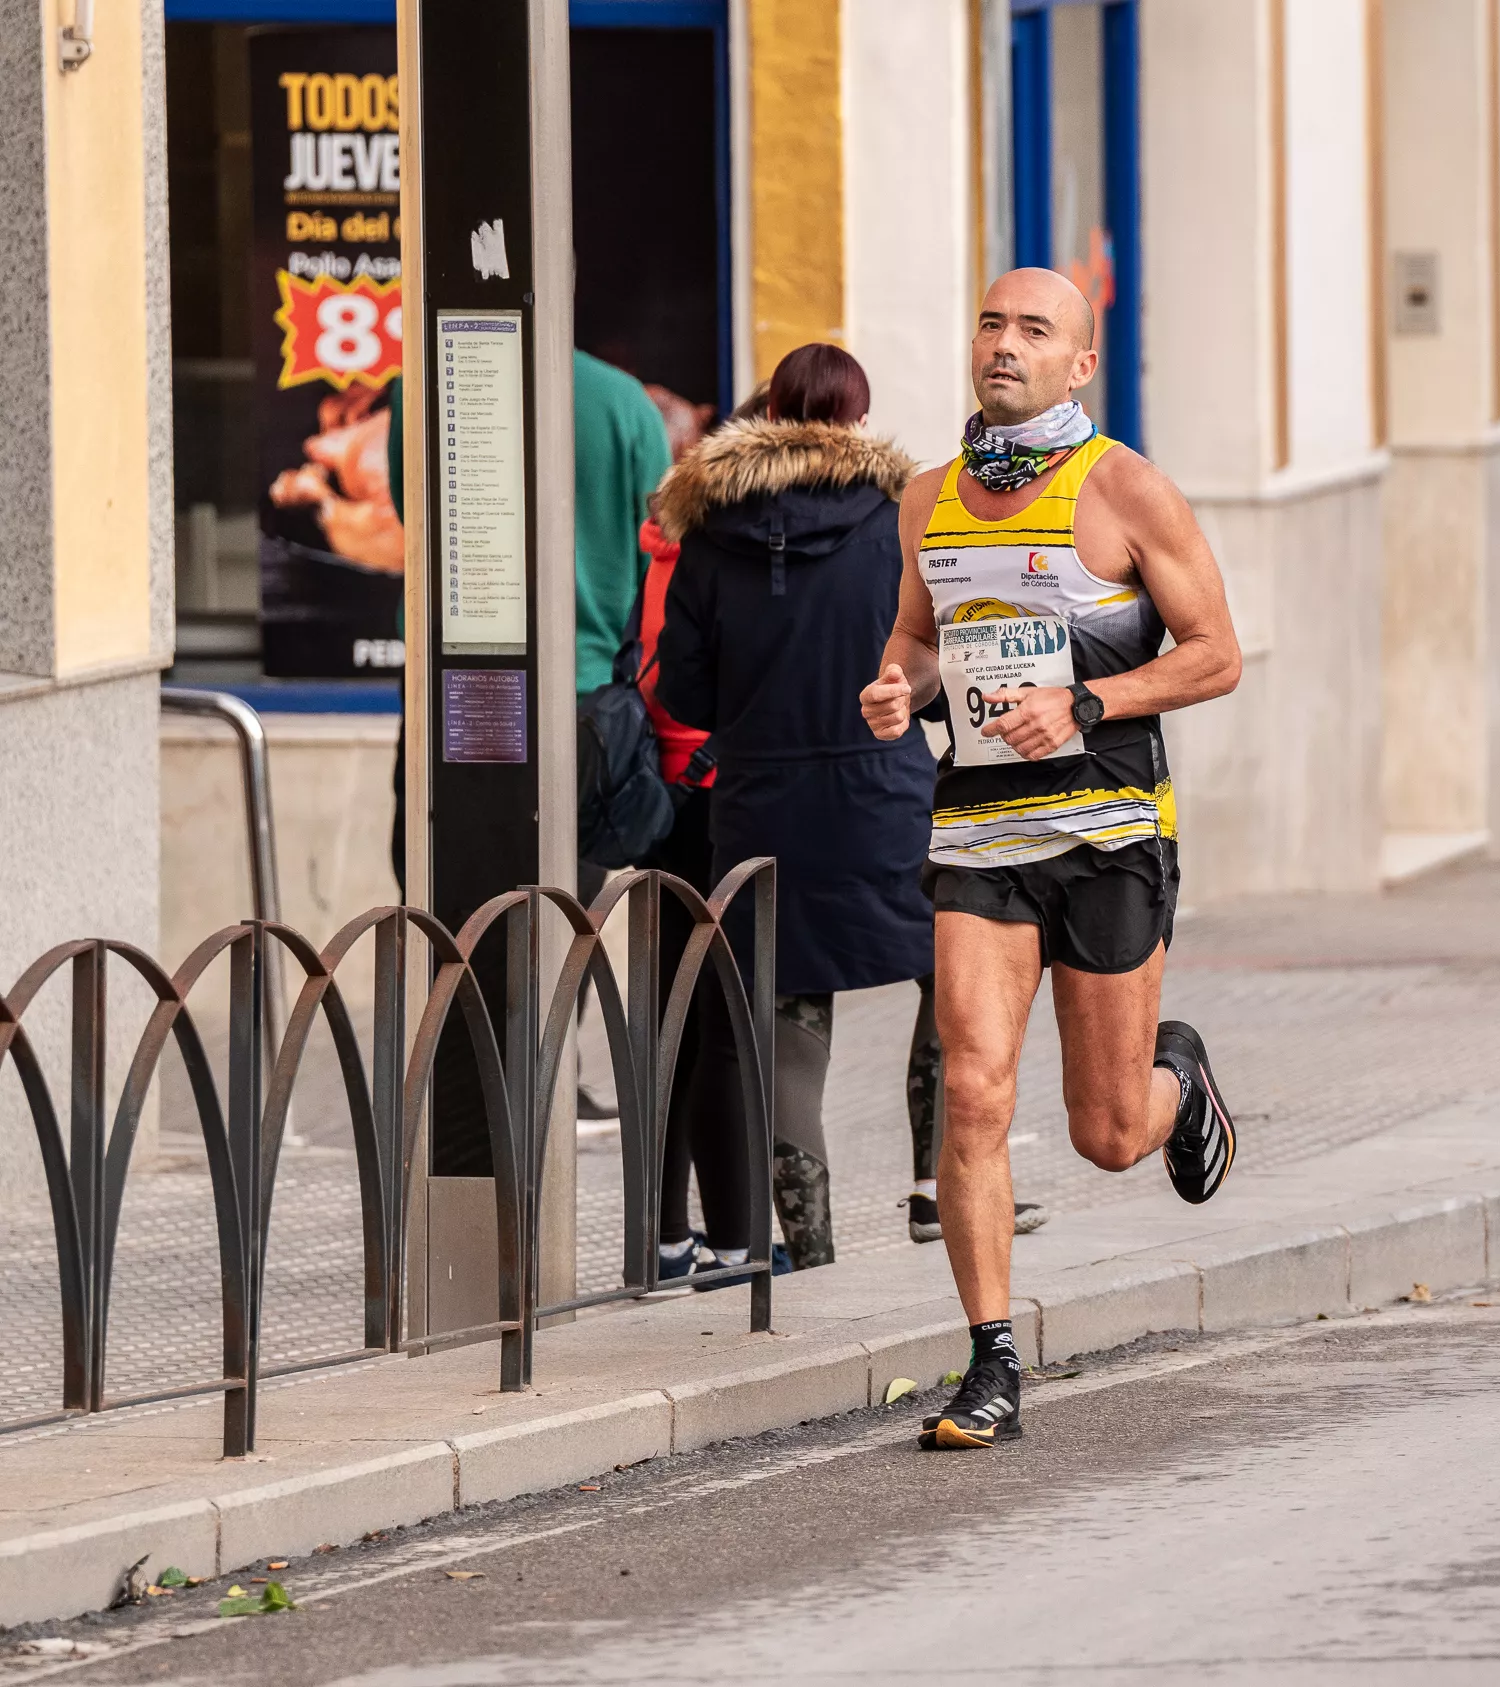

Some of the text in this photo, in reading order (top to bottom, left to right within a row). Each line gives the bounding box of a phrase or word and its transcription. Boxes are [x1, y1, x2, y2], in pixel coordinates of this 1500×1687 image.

[279, 72, 399, 132] TODOS
[286, 210, 338, 242] Día
[341, 211, 390, 242] del
[288, 251, 351, 279] Pollo
[928, 558, 957, 568] FASTER
[1021, 572, 1059, 581] Diputación
[1031, 580, 1059, 588] Córdoba
[960, 627, 988, 636] PROVINCIAL
[990, 625, 997, 633] DE
[998, 621, 1036, 640] 2024
[944, 633, 997, 645] CARRERAS POPULARES
[966, 682, 1037, 728] 94
